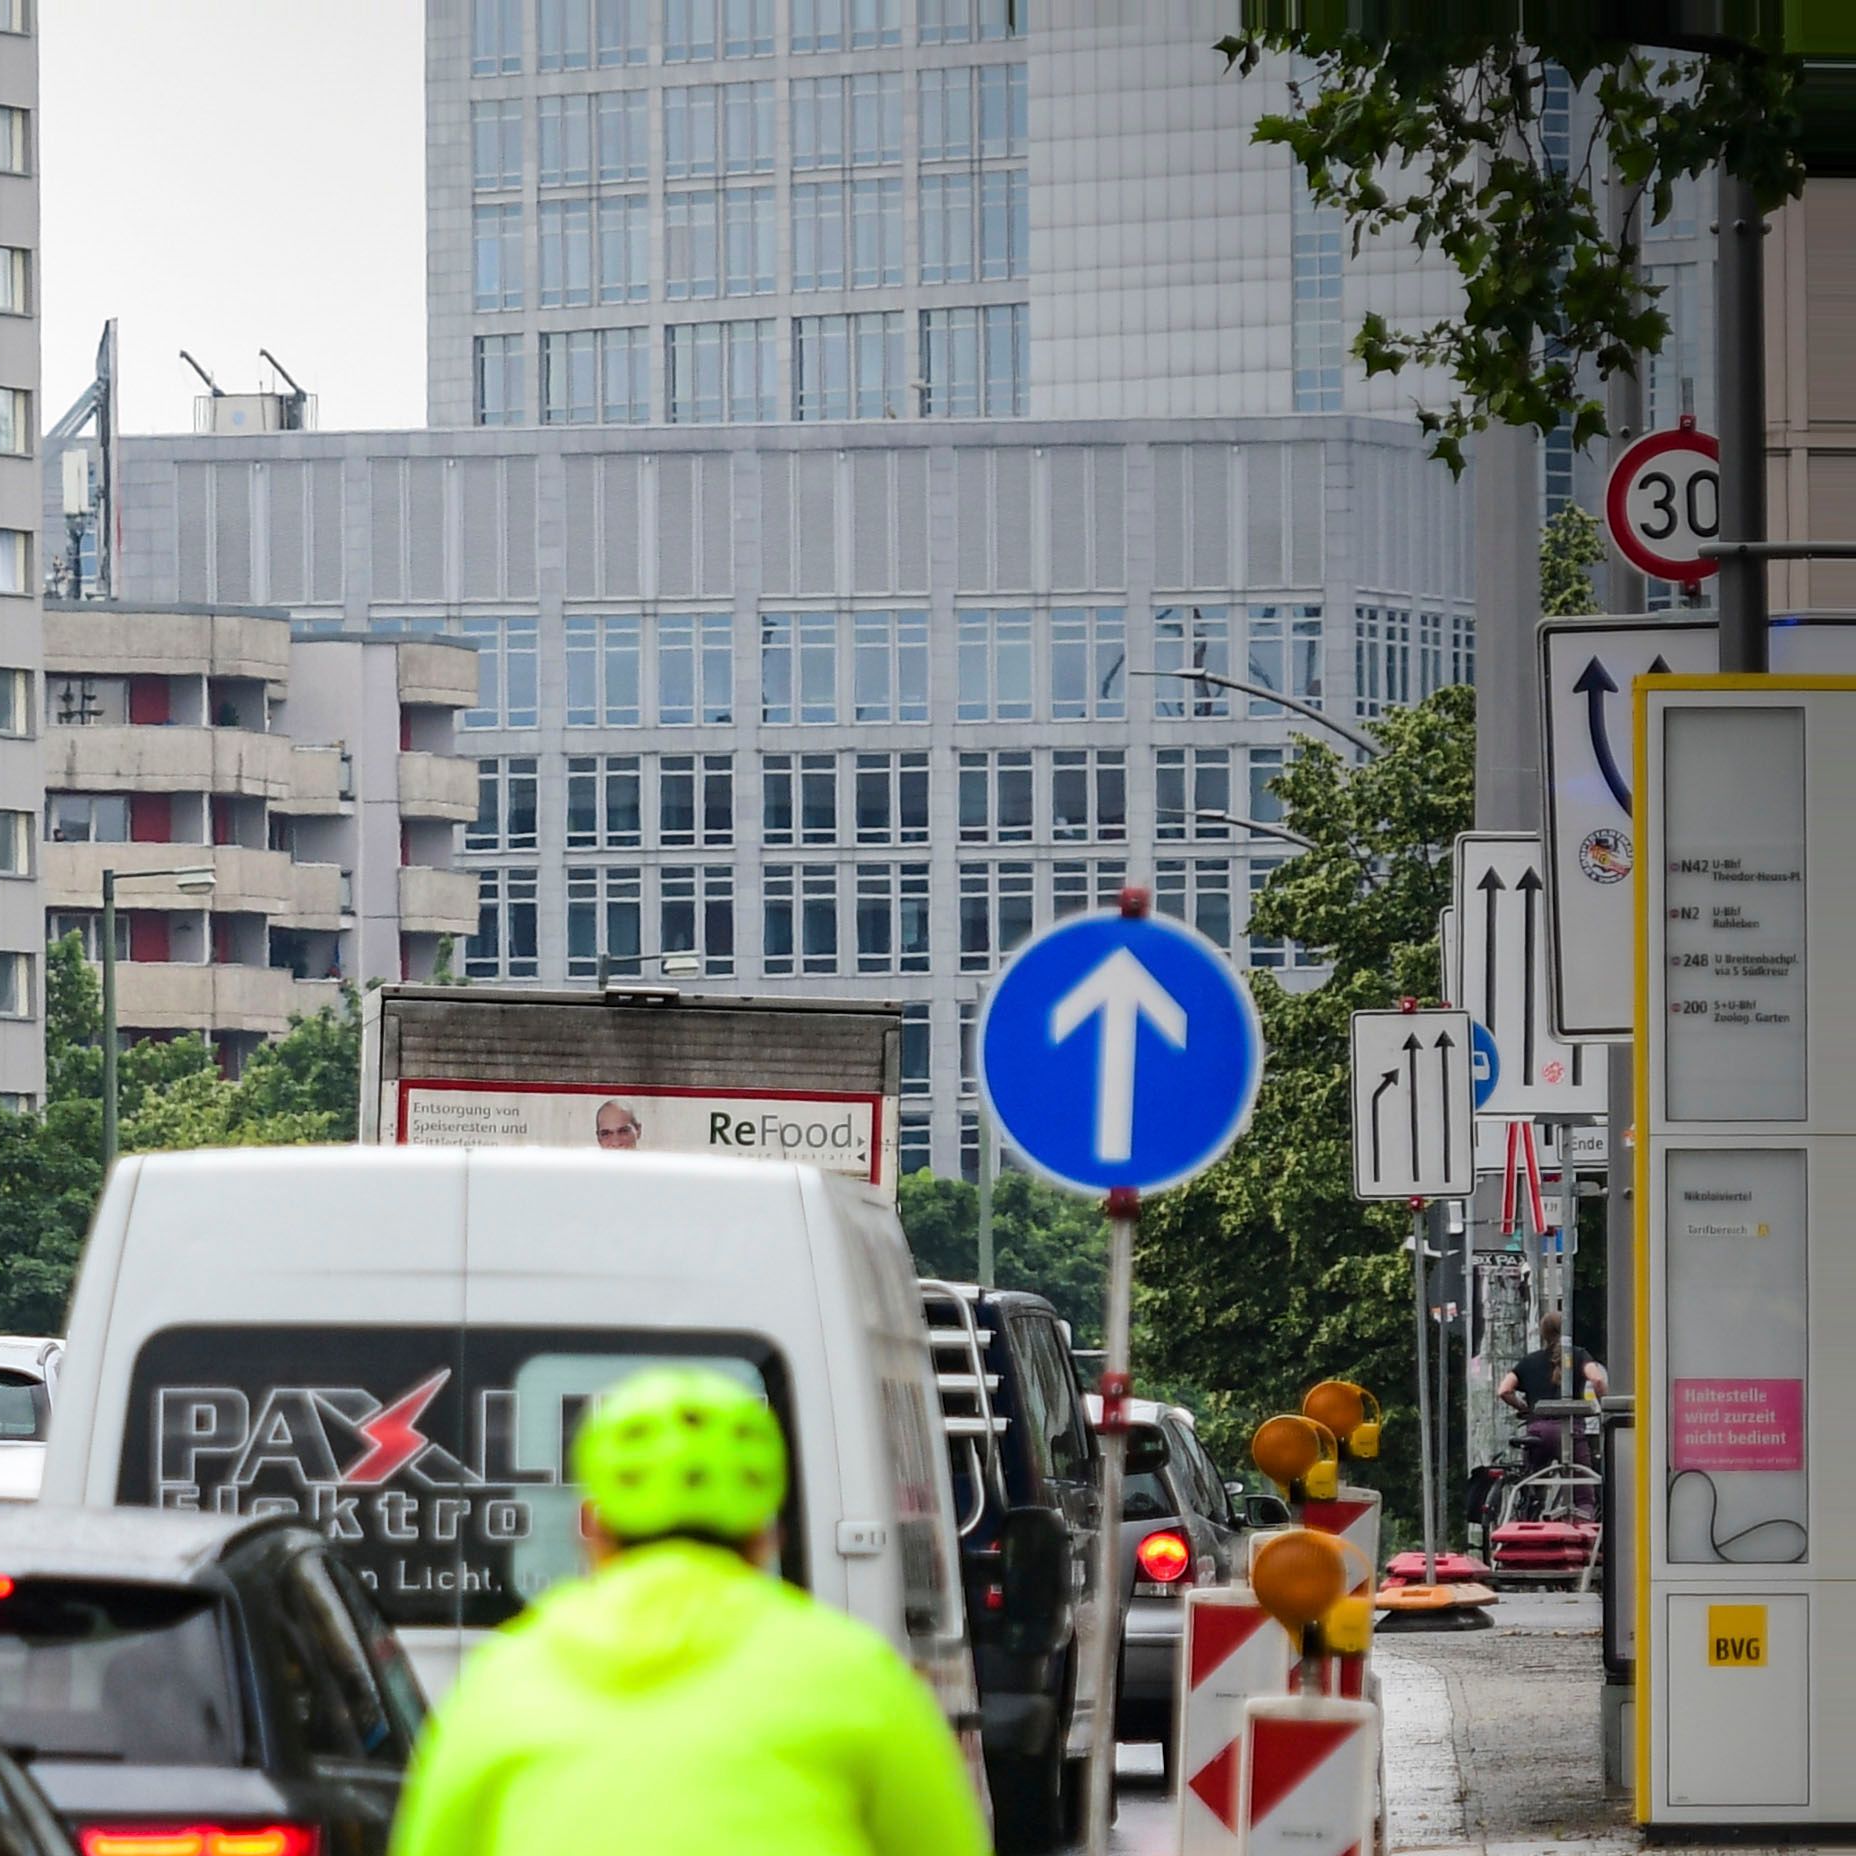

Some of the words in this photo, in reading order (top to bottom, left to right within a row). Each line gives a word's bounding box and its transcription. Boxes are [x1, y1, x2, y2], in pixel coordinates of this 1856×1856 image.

[1638, 470, 1719, 540] 30
[1681, 860, 1709, 873] N42
[1681, 907, 1700, 919] N2
[1683, 954, 1709, 967] 248
[1683, 1001, 1708, 1014] 200
[413, 1102, 491, 1118] Entsorgung
[496, 1106, 520, 1117] von
[413, 1120, 497, 1136] Speiseresten
[501, 1121, 528, 1134] und
[709, 1112, 852, 1148] ReFood
[1572, 1137, 1603, 1151] Ende
[1685, 1387, 1767, 1402] Haltestelle
[1684, 1409, 1719, 1423] wird
[1723, 1409, 1776, 1423] zurzeit
[1684, 1429, 1723, 1444] nicht
[1728, 1430, 1787, 1444] bedient
[1715, 1637, 1761, 1661] BVG
